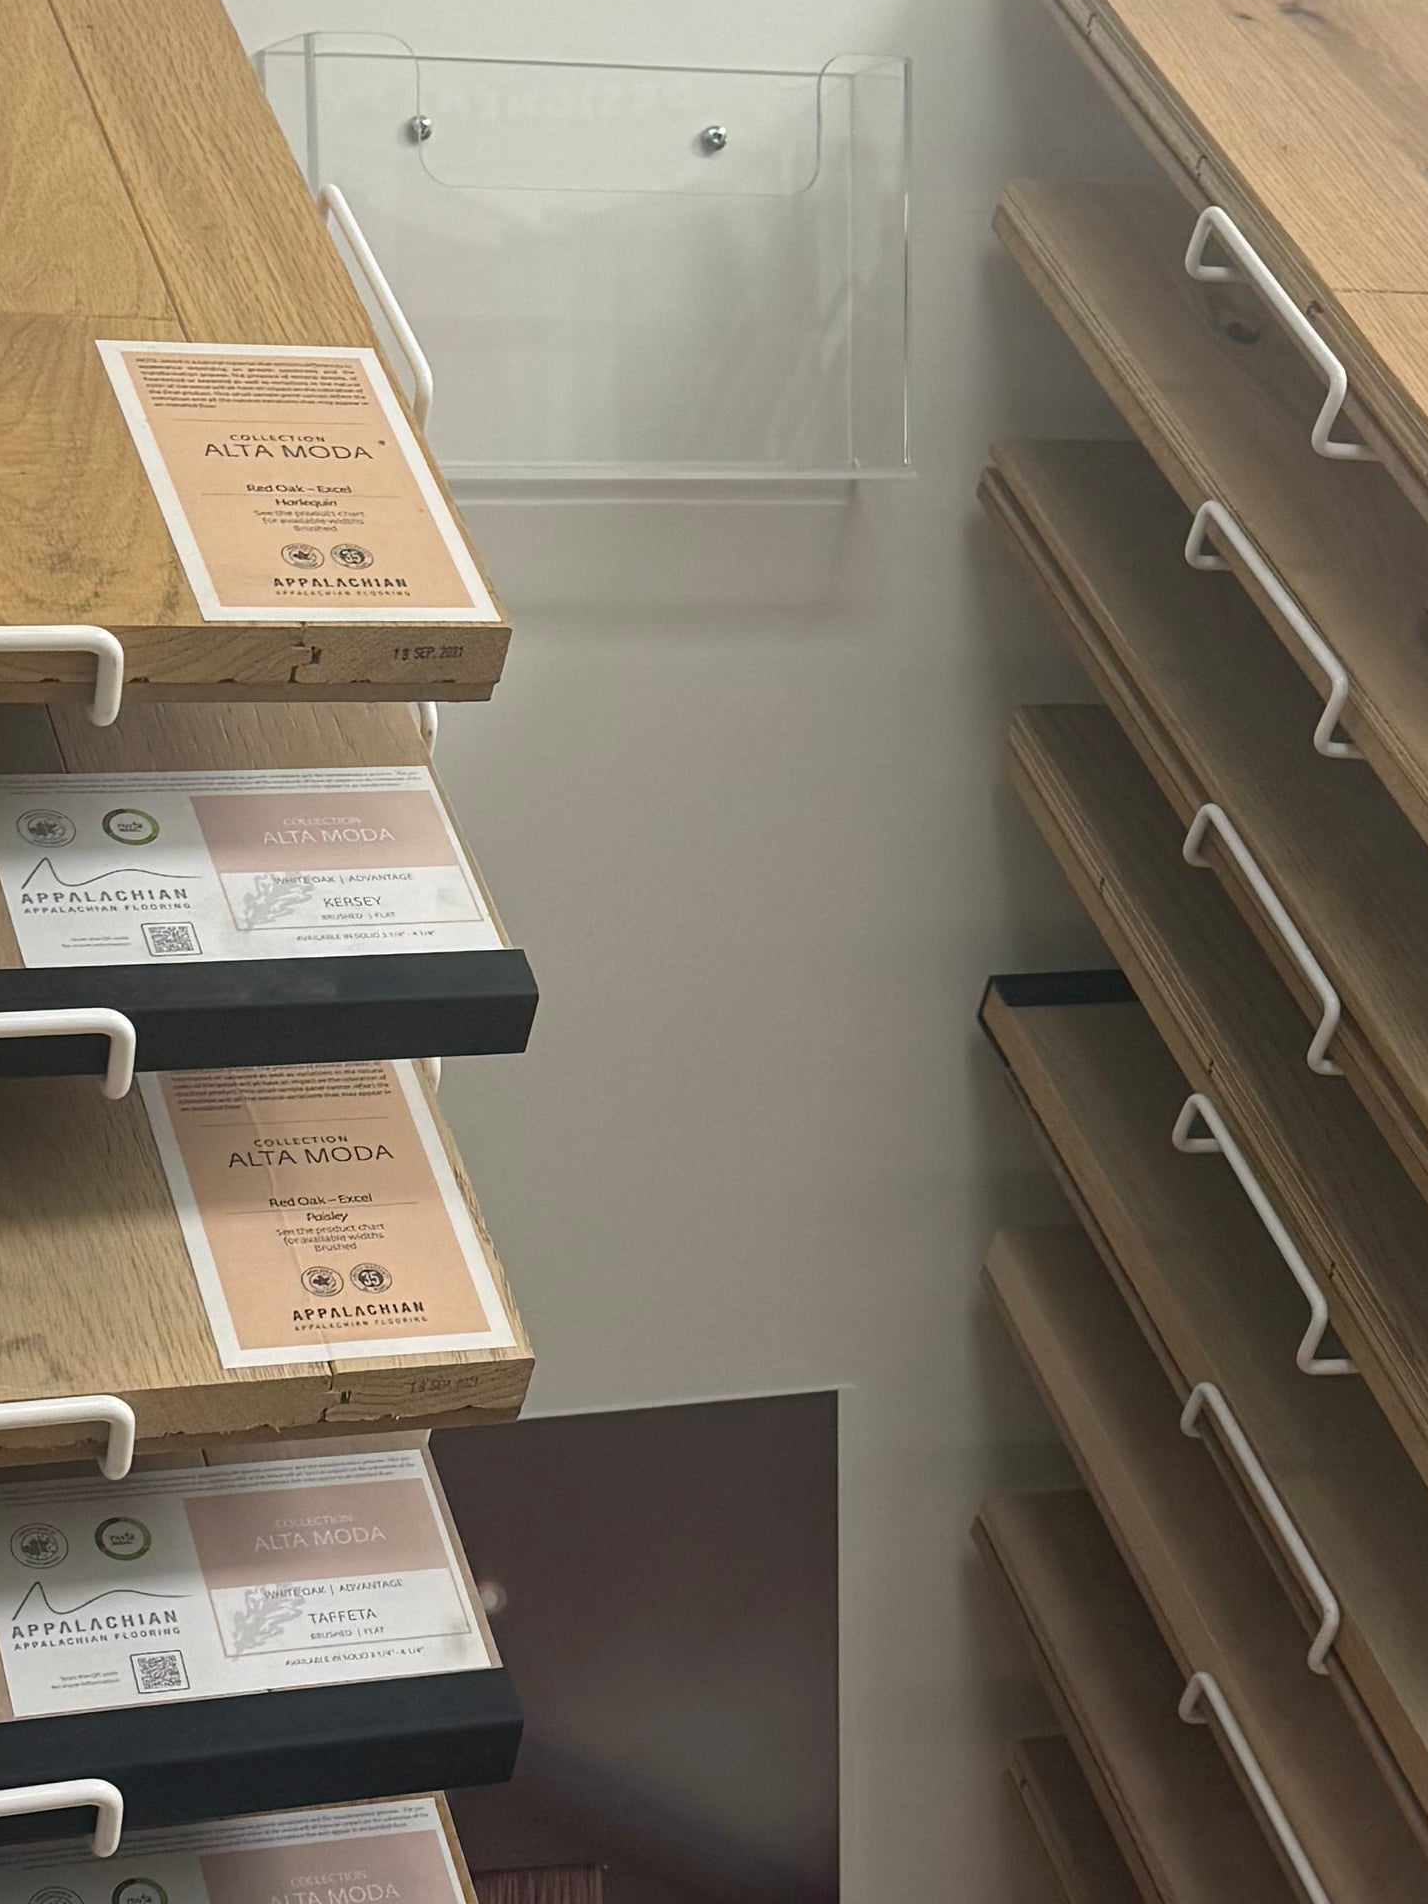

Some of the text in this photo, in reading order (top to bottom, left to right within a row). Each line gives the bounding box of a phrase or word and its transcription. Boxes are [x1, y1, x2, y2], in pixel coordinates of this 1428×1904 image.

[205, 444, 373, 459] ALTA MODA
[247, 484, 273, 492] Red
[276, 499, 337, 508] Harlequin
[274, 578, 407, 587] APPALACHIAN
[284, 816, 361, 826] COLLECTION
[264, 828, 395, 844] ALTA MODA
[274, 876, 312, 885] WHITE
[349, 873, 414, 882] ADVANTAGE
[21, 889, 188, 904] APPALACHIAN
[324, 897, 381, 907] KERSEY
[24, 903, 191, 914] APPALACHIAN FLOORING
[254, 1136, 348, 1147] COLLECTION
[229, 1144, 394, 1168] ALTA MODA
[269, 1194, 373, 1208] Red Oak Excel
[307, 1212, 348, 1223] Paisley
[364, 1271, 379, 1287] 35
[293, 1301, 424, 1321] APPALACHIAN
[276, 1514, 352, 1528] COLLECTION
[254, 1527, 386, 1552] ALTA MODA
[302, 1586, 326, 1596] OAK
[339, 1579, 402, 1592] ADVANTAGE
[308, 1608, 378, 1624] TAFFETA
[12, 1610, 178, 1639] APPALACHIAN
[14, 1627, 181, 1651] APPALACHIAN FLOORING
[291, 1870, 367, 1887] COLLECTION
